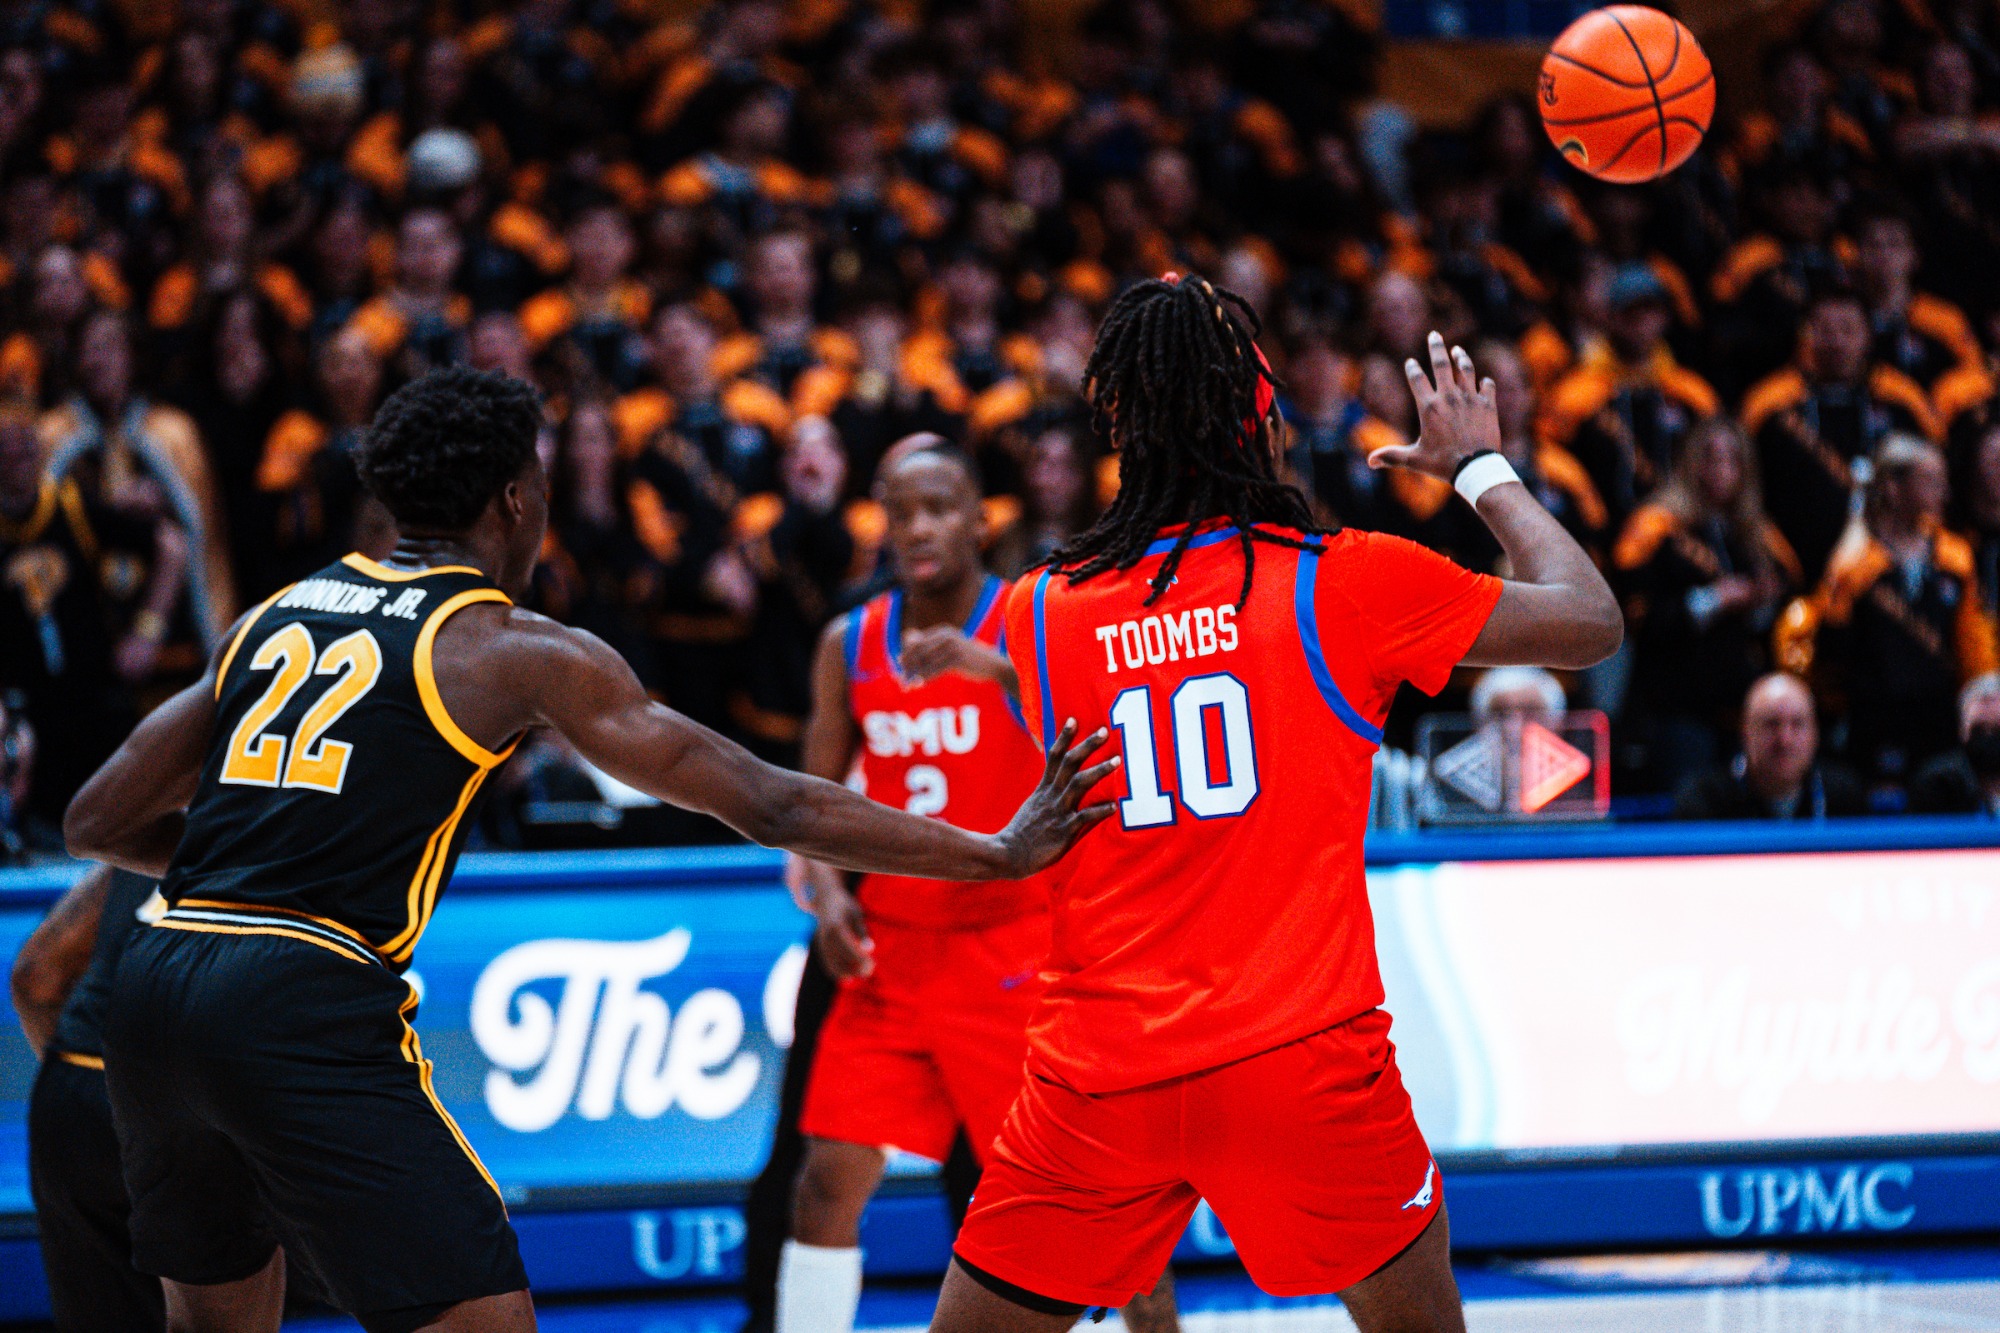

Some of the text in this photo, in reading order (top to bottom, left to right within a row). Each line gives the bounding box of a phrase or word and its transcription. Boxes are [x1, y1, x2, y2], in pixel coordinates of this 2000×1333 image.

[382, 587, 427, 620] JR.
[1096, 605, 1238, 673] TOOMBS
[219, 621, 383, 795] 22
[863, 704, 980, 756] SMU
[1109, 670, 1261, 830] 10
[904, 765, 949, 819] 2
[470, 926, 761, 1132] The
[1700, 1163, 1916, 1237] UPMC
[631, 1208, 747, 1279] UP
